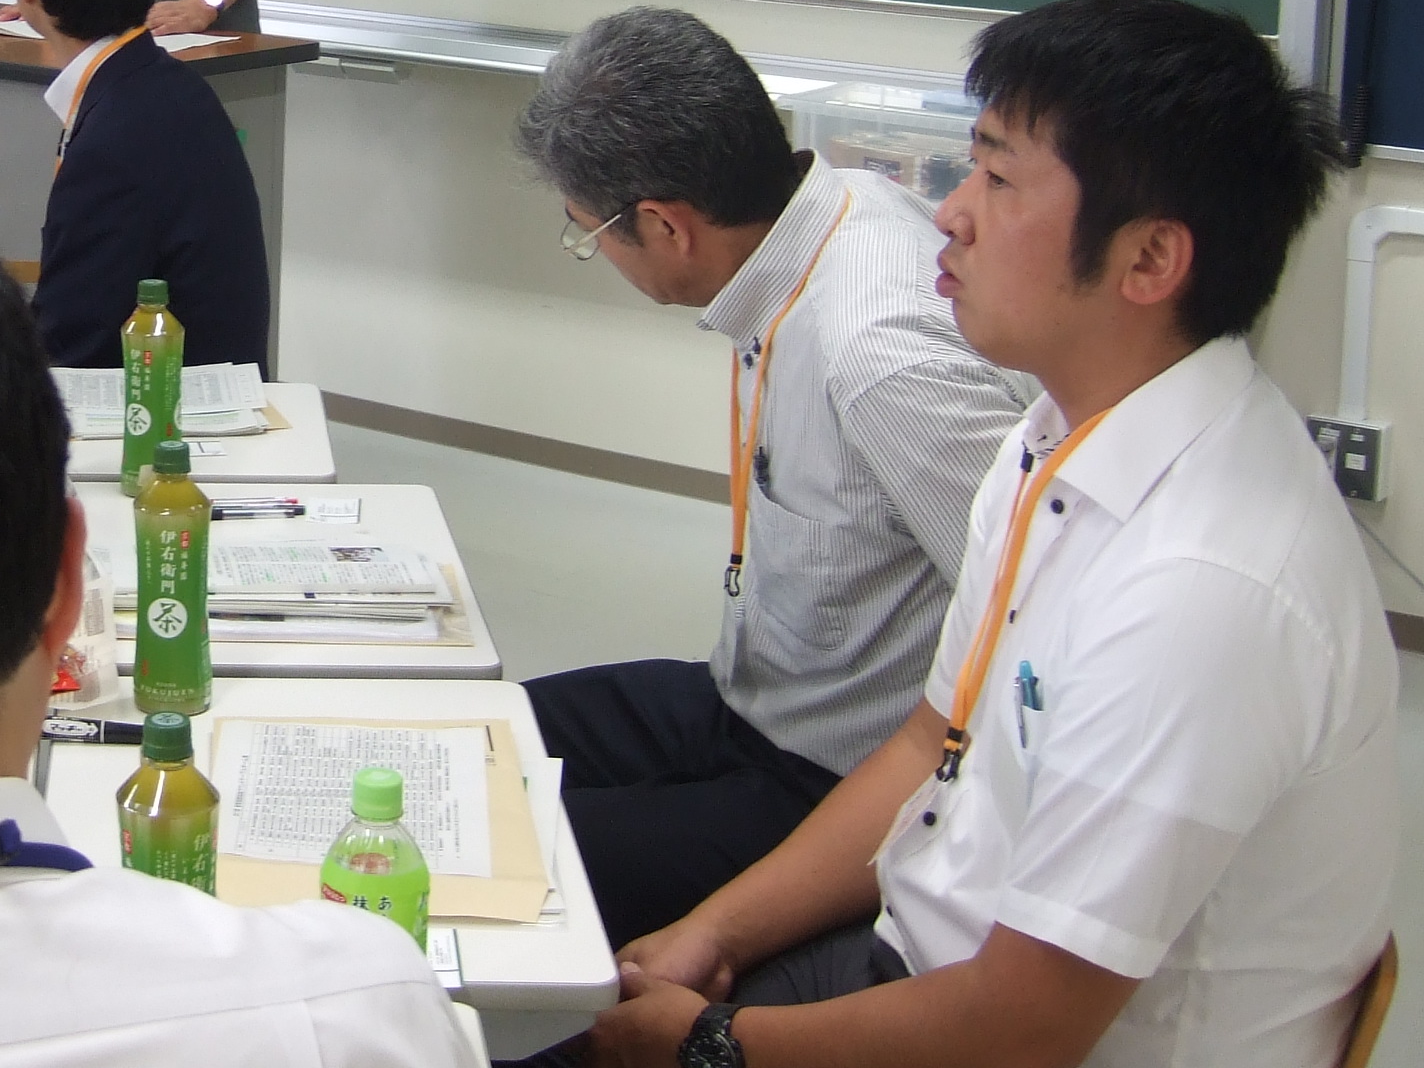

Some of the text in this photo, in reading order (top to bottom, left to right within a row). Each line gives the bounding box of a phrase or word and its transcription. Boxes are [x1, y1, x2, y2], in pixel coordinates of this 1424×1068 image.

[159, 530, 177, 594] 伊右衛門
[152, 602, 184, 634] 茶
